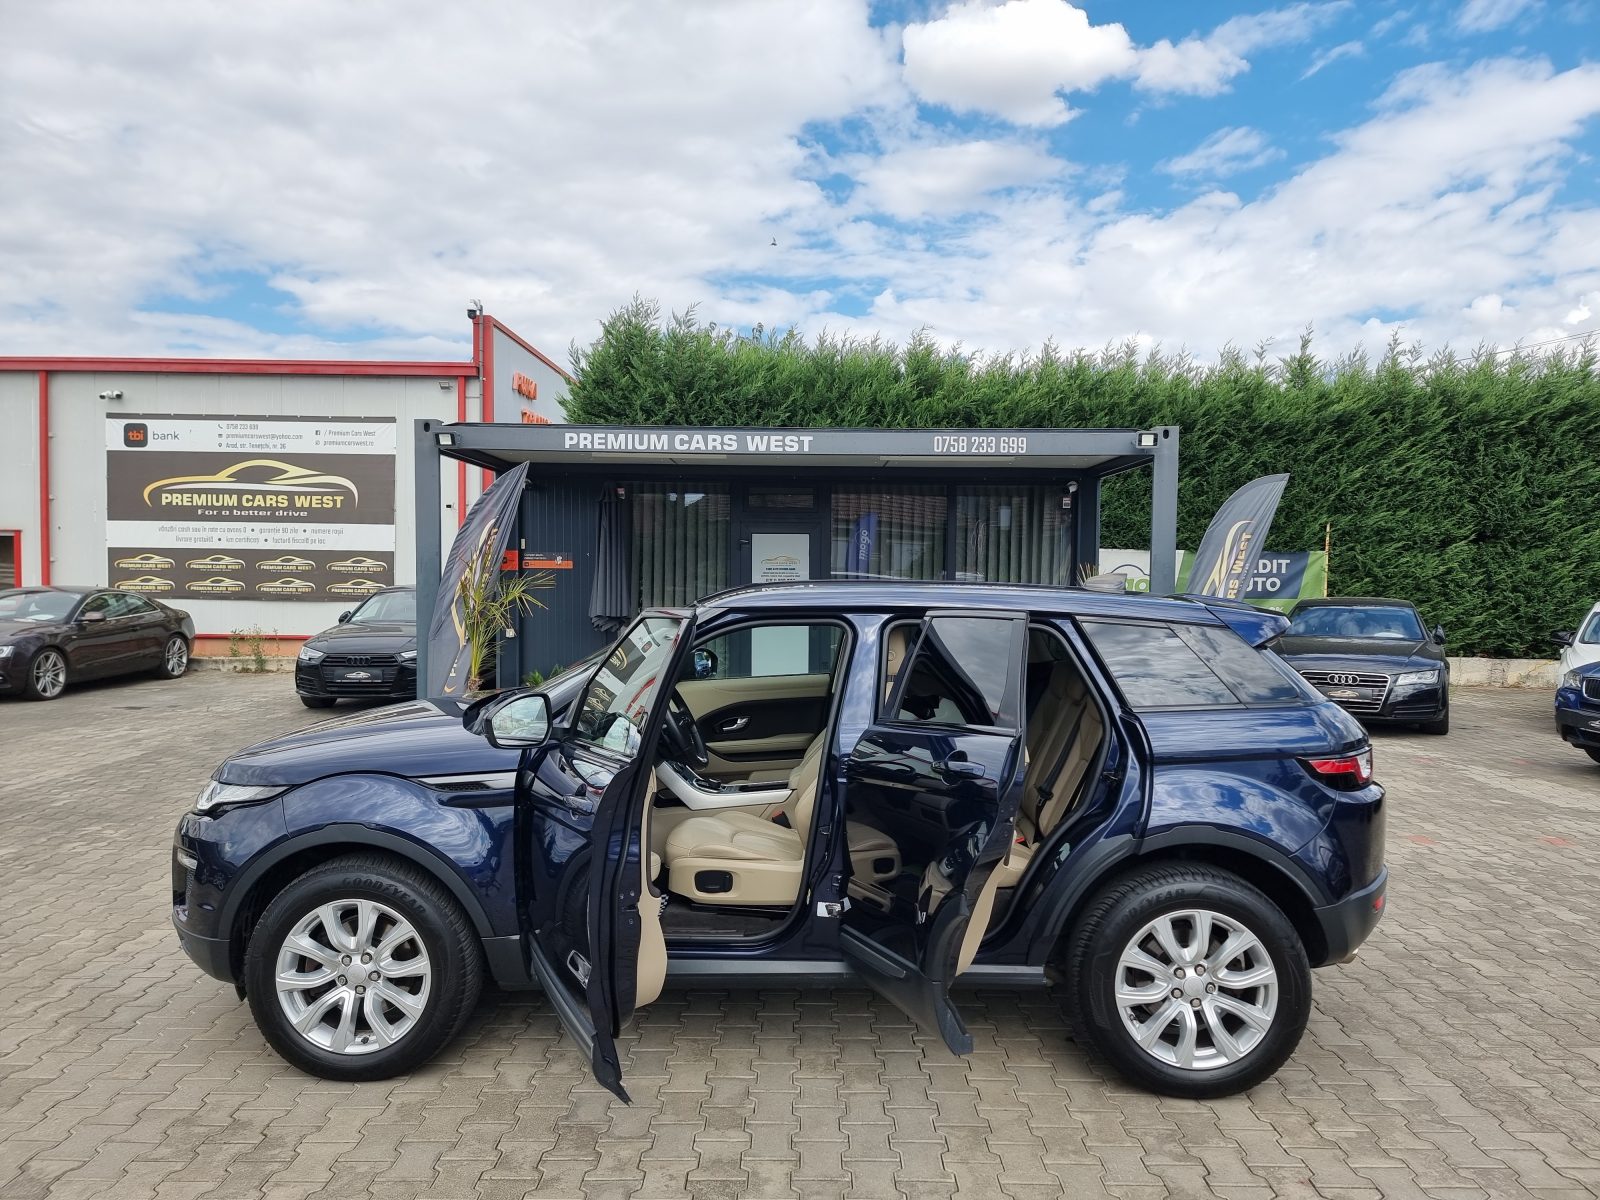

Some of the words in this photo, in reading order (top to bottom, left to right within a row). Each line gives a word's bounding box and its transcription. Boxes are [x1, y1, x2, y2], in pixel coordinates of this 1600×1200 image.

[127, 431, 144, 441] tbi
[152, 431, 180, 441] bank
[328, 429, 351, 437] Premium
[564, 432, 668, 450] PREMIUM
[674, 434, 737, 451] CARS
[746, 435, 814, 452] WEST
[934, 436, 967, 453] 0758
[971, 436, 996, 453] 233
[1000, 437, 1027, 453] 699
[161, 493, 238, 507] PREMIUM
[241, 494, 289, 508] CARS
[294, 495, 344, 508] WEST
[233, 509, 272, 517] better
[275, 509, 308, 517] drive
[859, 529, 870, 560] mogo
[1230, 532, 1252, 574] WEST
[1254, 559, 1291, 574] DIT
[343, 877, 426, 913] GOODYEAR
